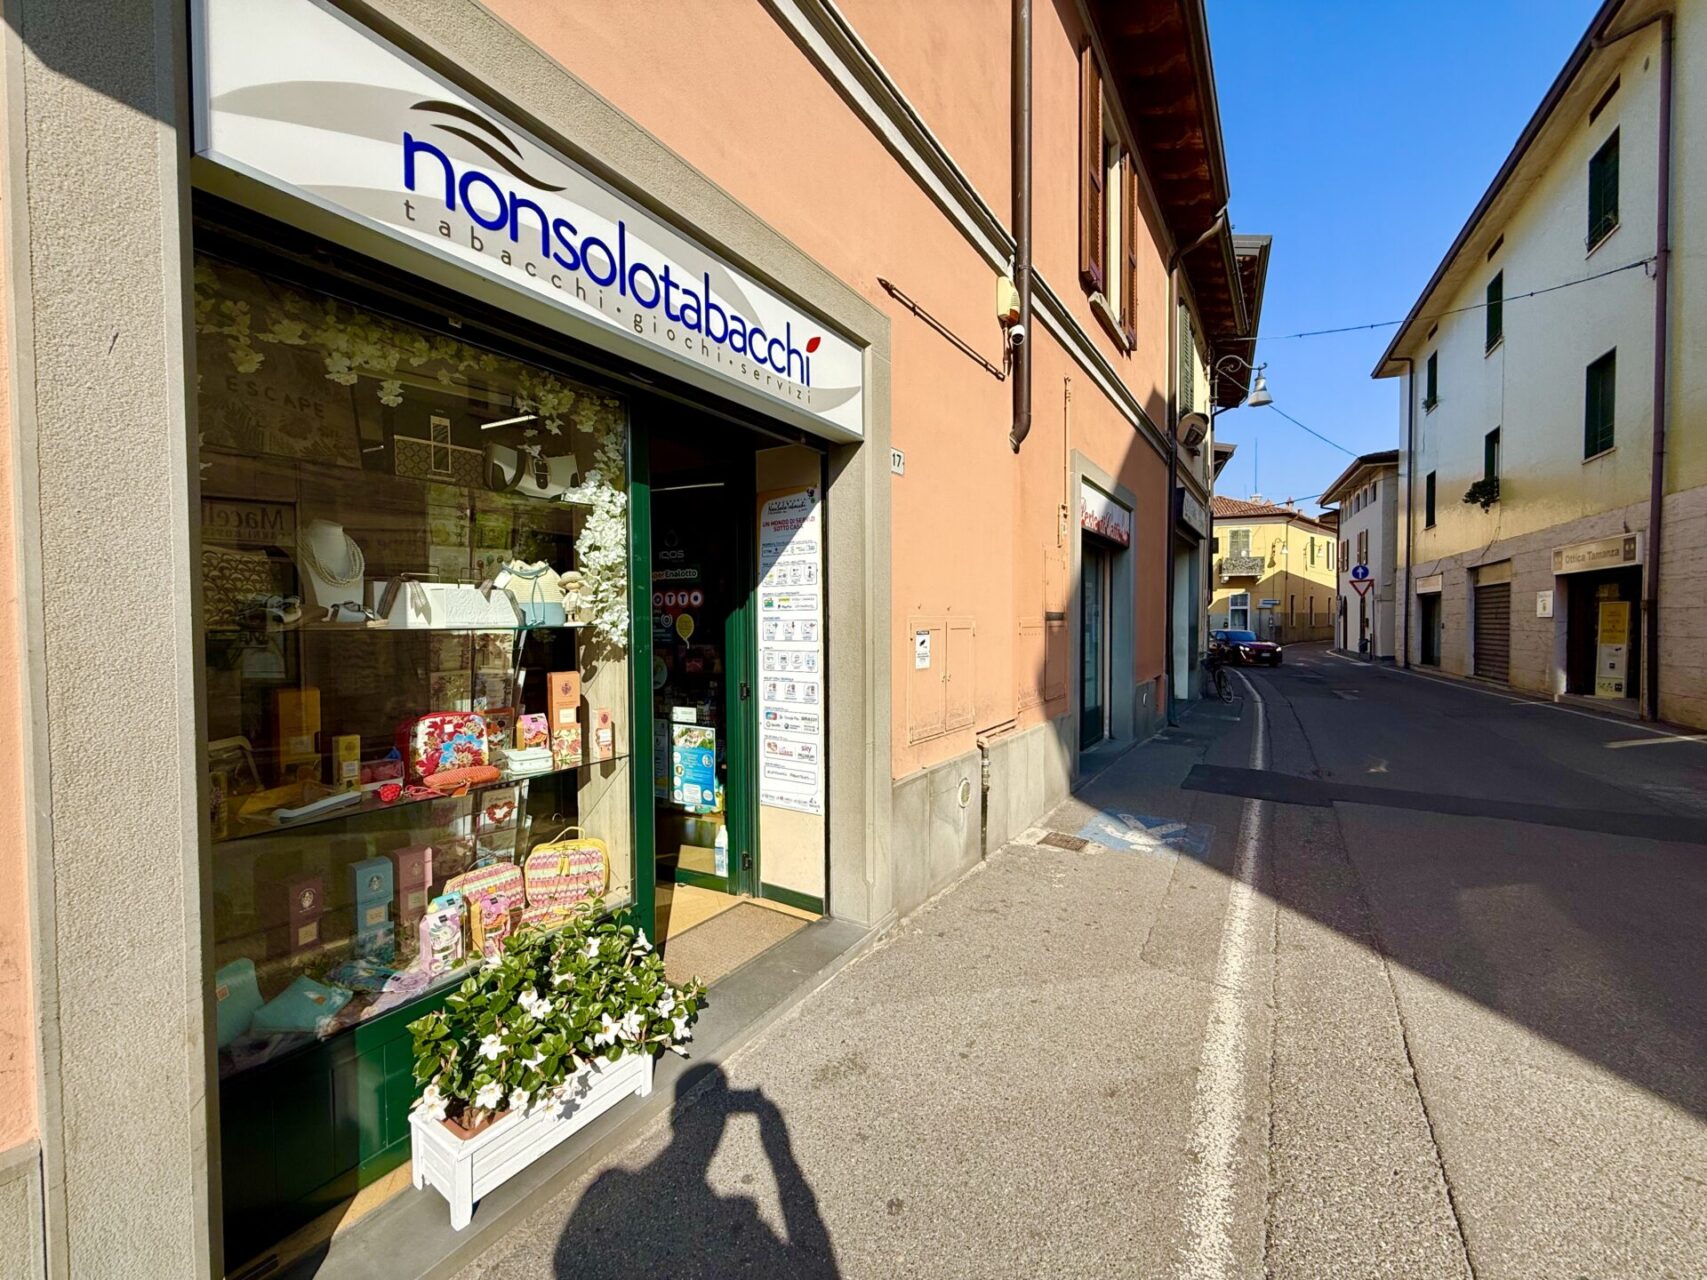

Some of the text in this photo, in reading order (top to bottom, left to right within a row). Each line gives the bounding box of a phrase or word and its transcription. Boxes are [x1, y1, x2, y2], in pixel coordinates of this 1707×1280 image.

[403, 131, 815, 388] nonsolotabacchi
[403, 199, 812, 404] tabacchi giochi servizi
[225, 375, 325, 420] ESCAPE
[892, 452, 902, 468] 17
